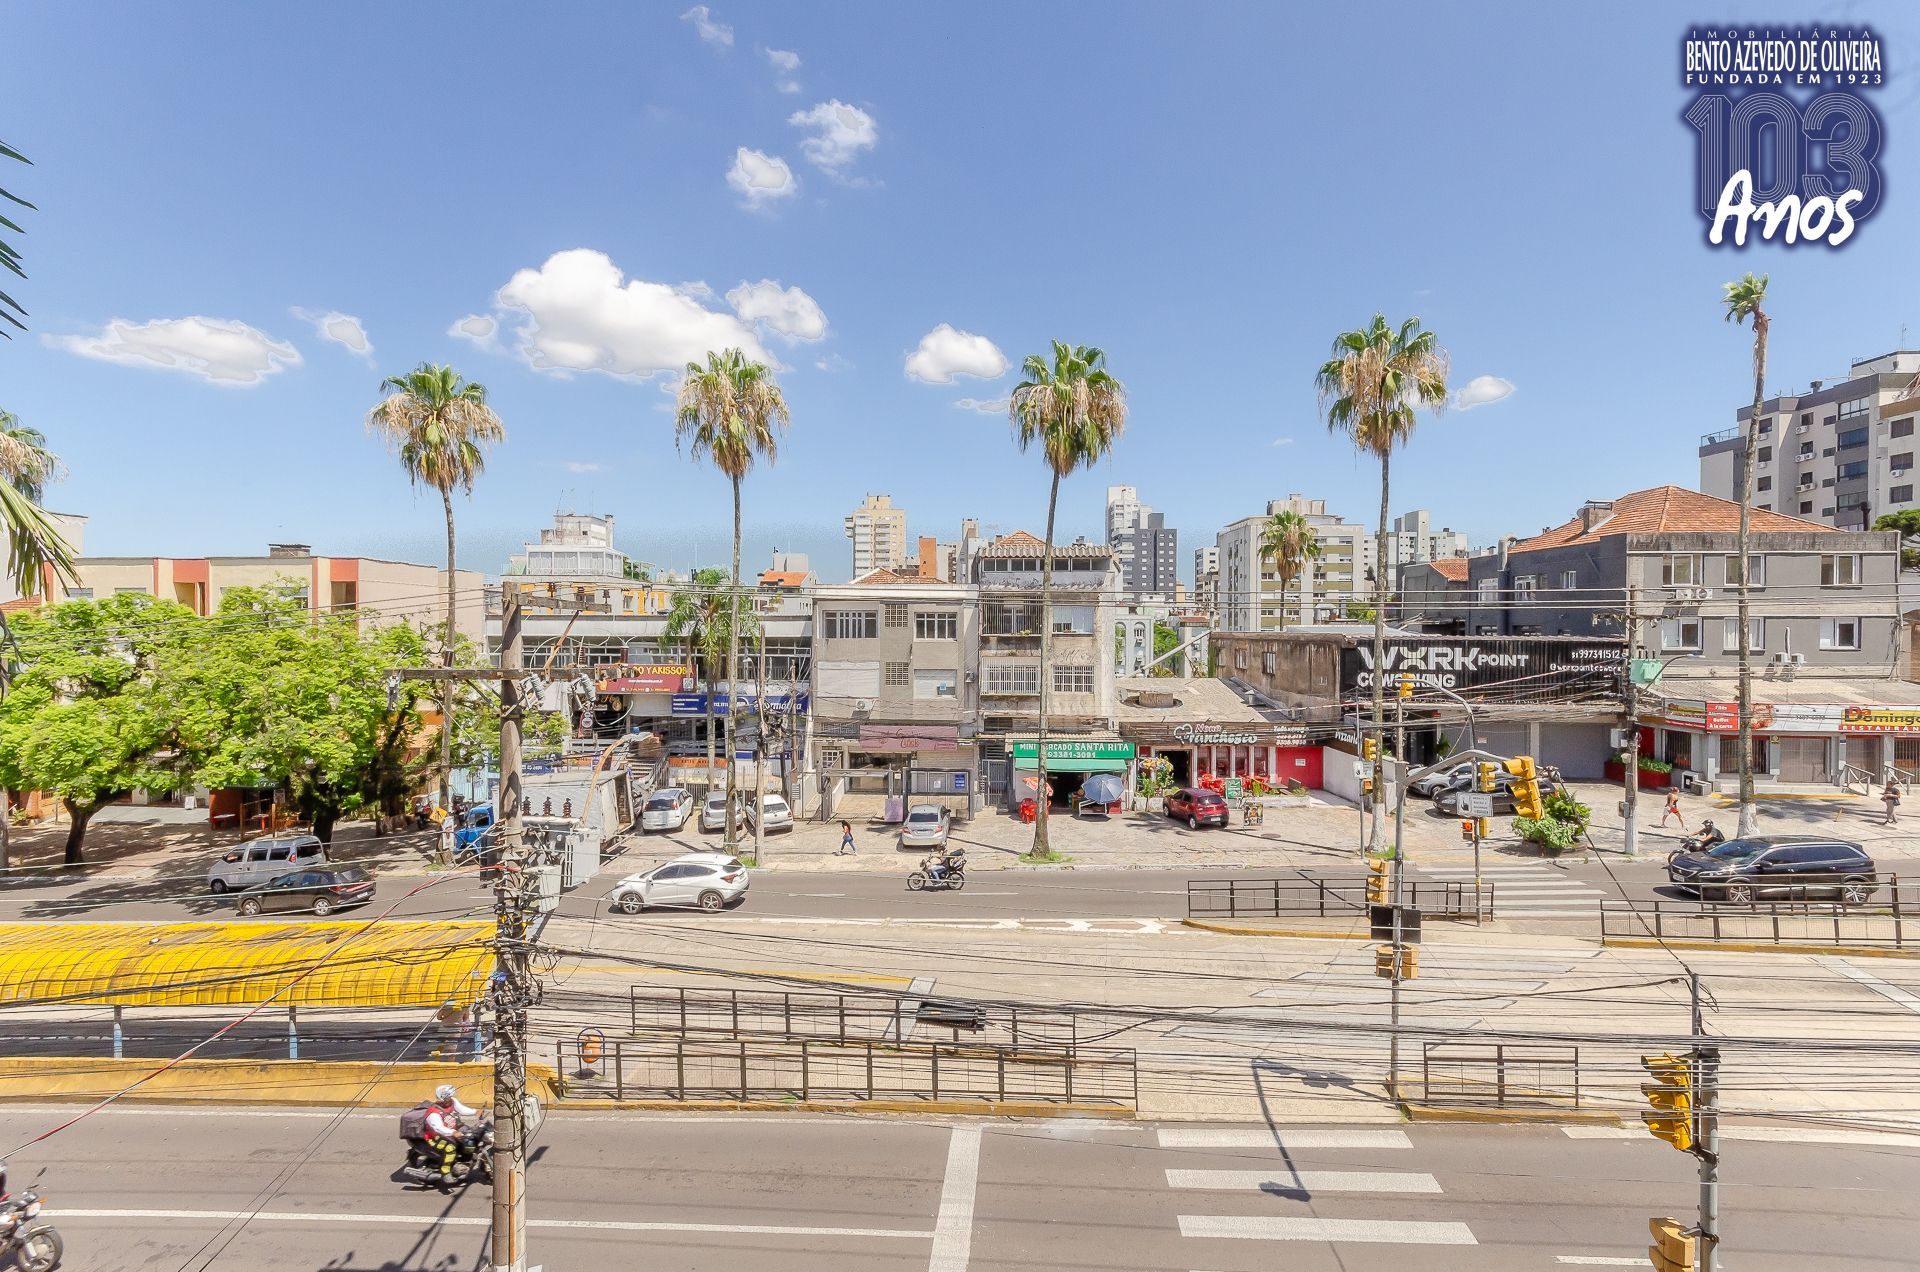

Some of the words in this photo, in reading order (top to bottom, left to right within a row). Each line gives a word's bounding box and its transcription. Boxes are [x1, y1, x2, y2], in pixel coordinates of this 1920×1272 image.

[1478, 654, 1529, 667] POINT
[1357, 672, 1456, 688] CWKING
[1074, 742, 1105, 751] SANTA
[1108, 743, 1129, 752] RITA
